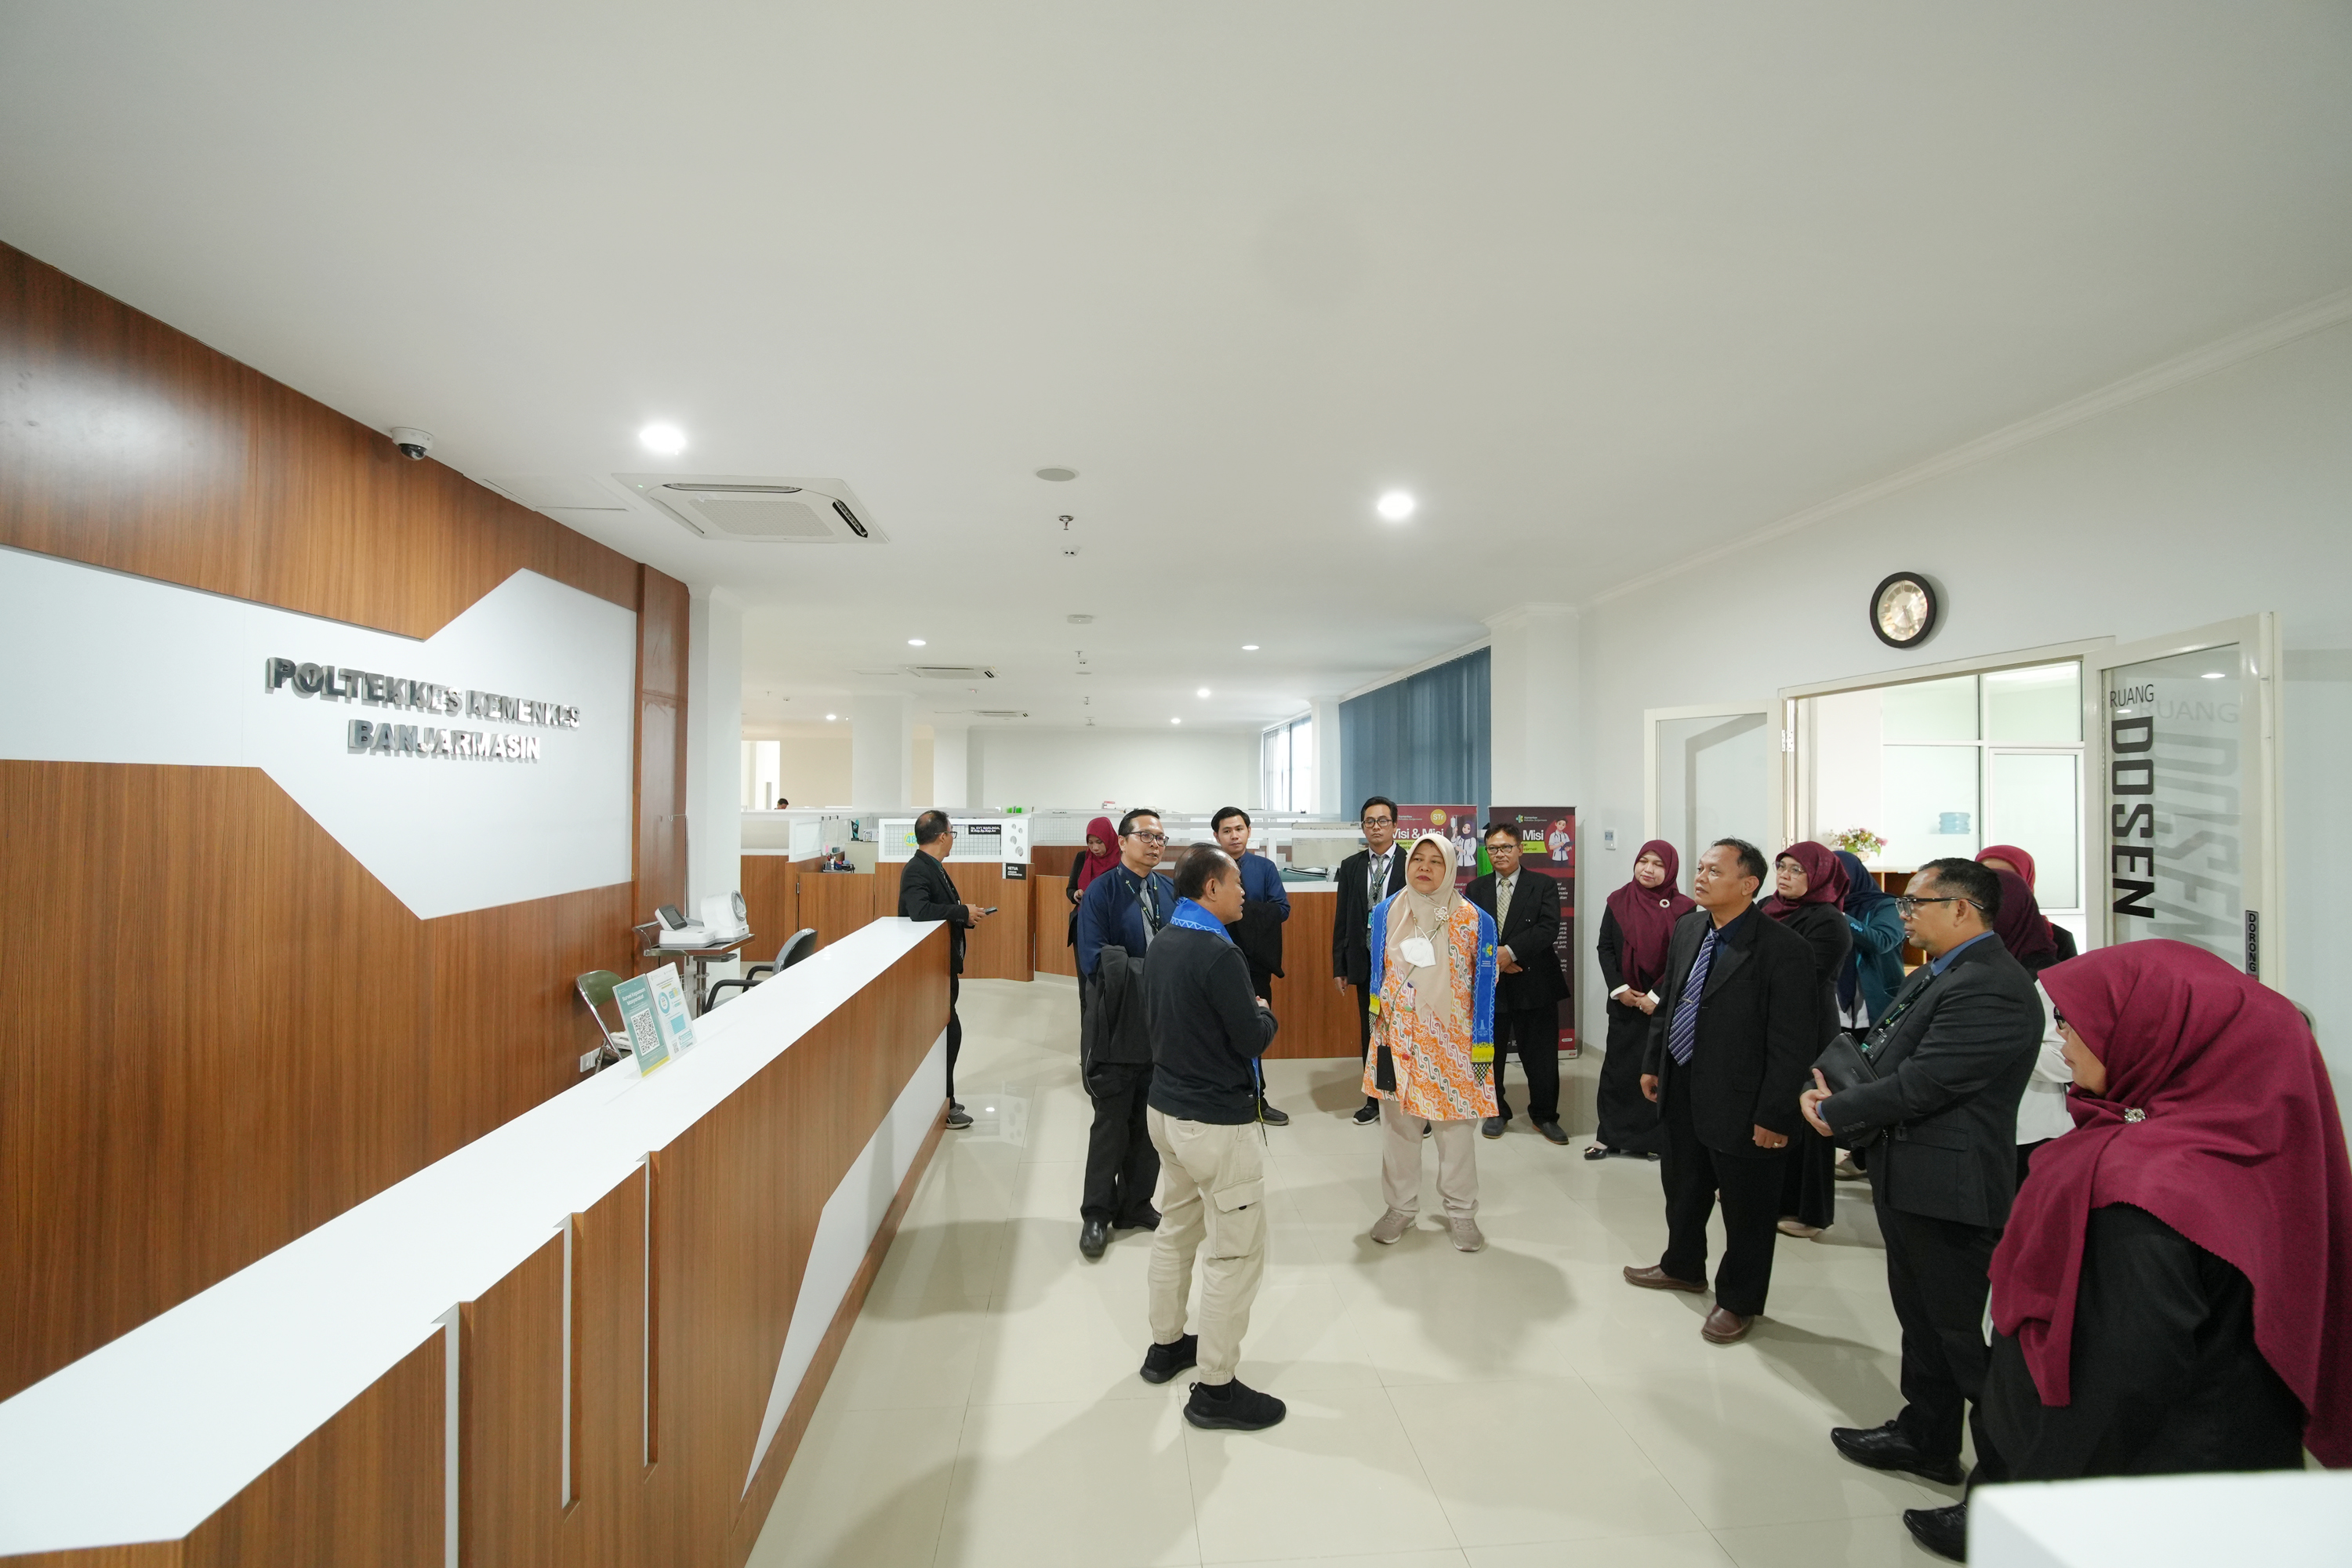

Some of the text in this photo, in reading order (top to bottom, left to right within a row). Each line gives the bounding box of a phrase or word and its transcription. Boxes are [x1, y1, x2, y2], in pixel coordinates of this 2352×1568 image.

[267, 657, 581, 728] POLTEKKES KEMENKES
[2110, 684, 2154, 708] RUANG
[348, 719, 541, 760] BANJARMASIN
[2111, 716, 2155, 919] DOSEN
[906, 835, 916, 844] 48
[1392, 828, 1410, 839] Visi
[1411, 828, 1421, 839] &
[1523, 829, 1544, 840] Misi
